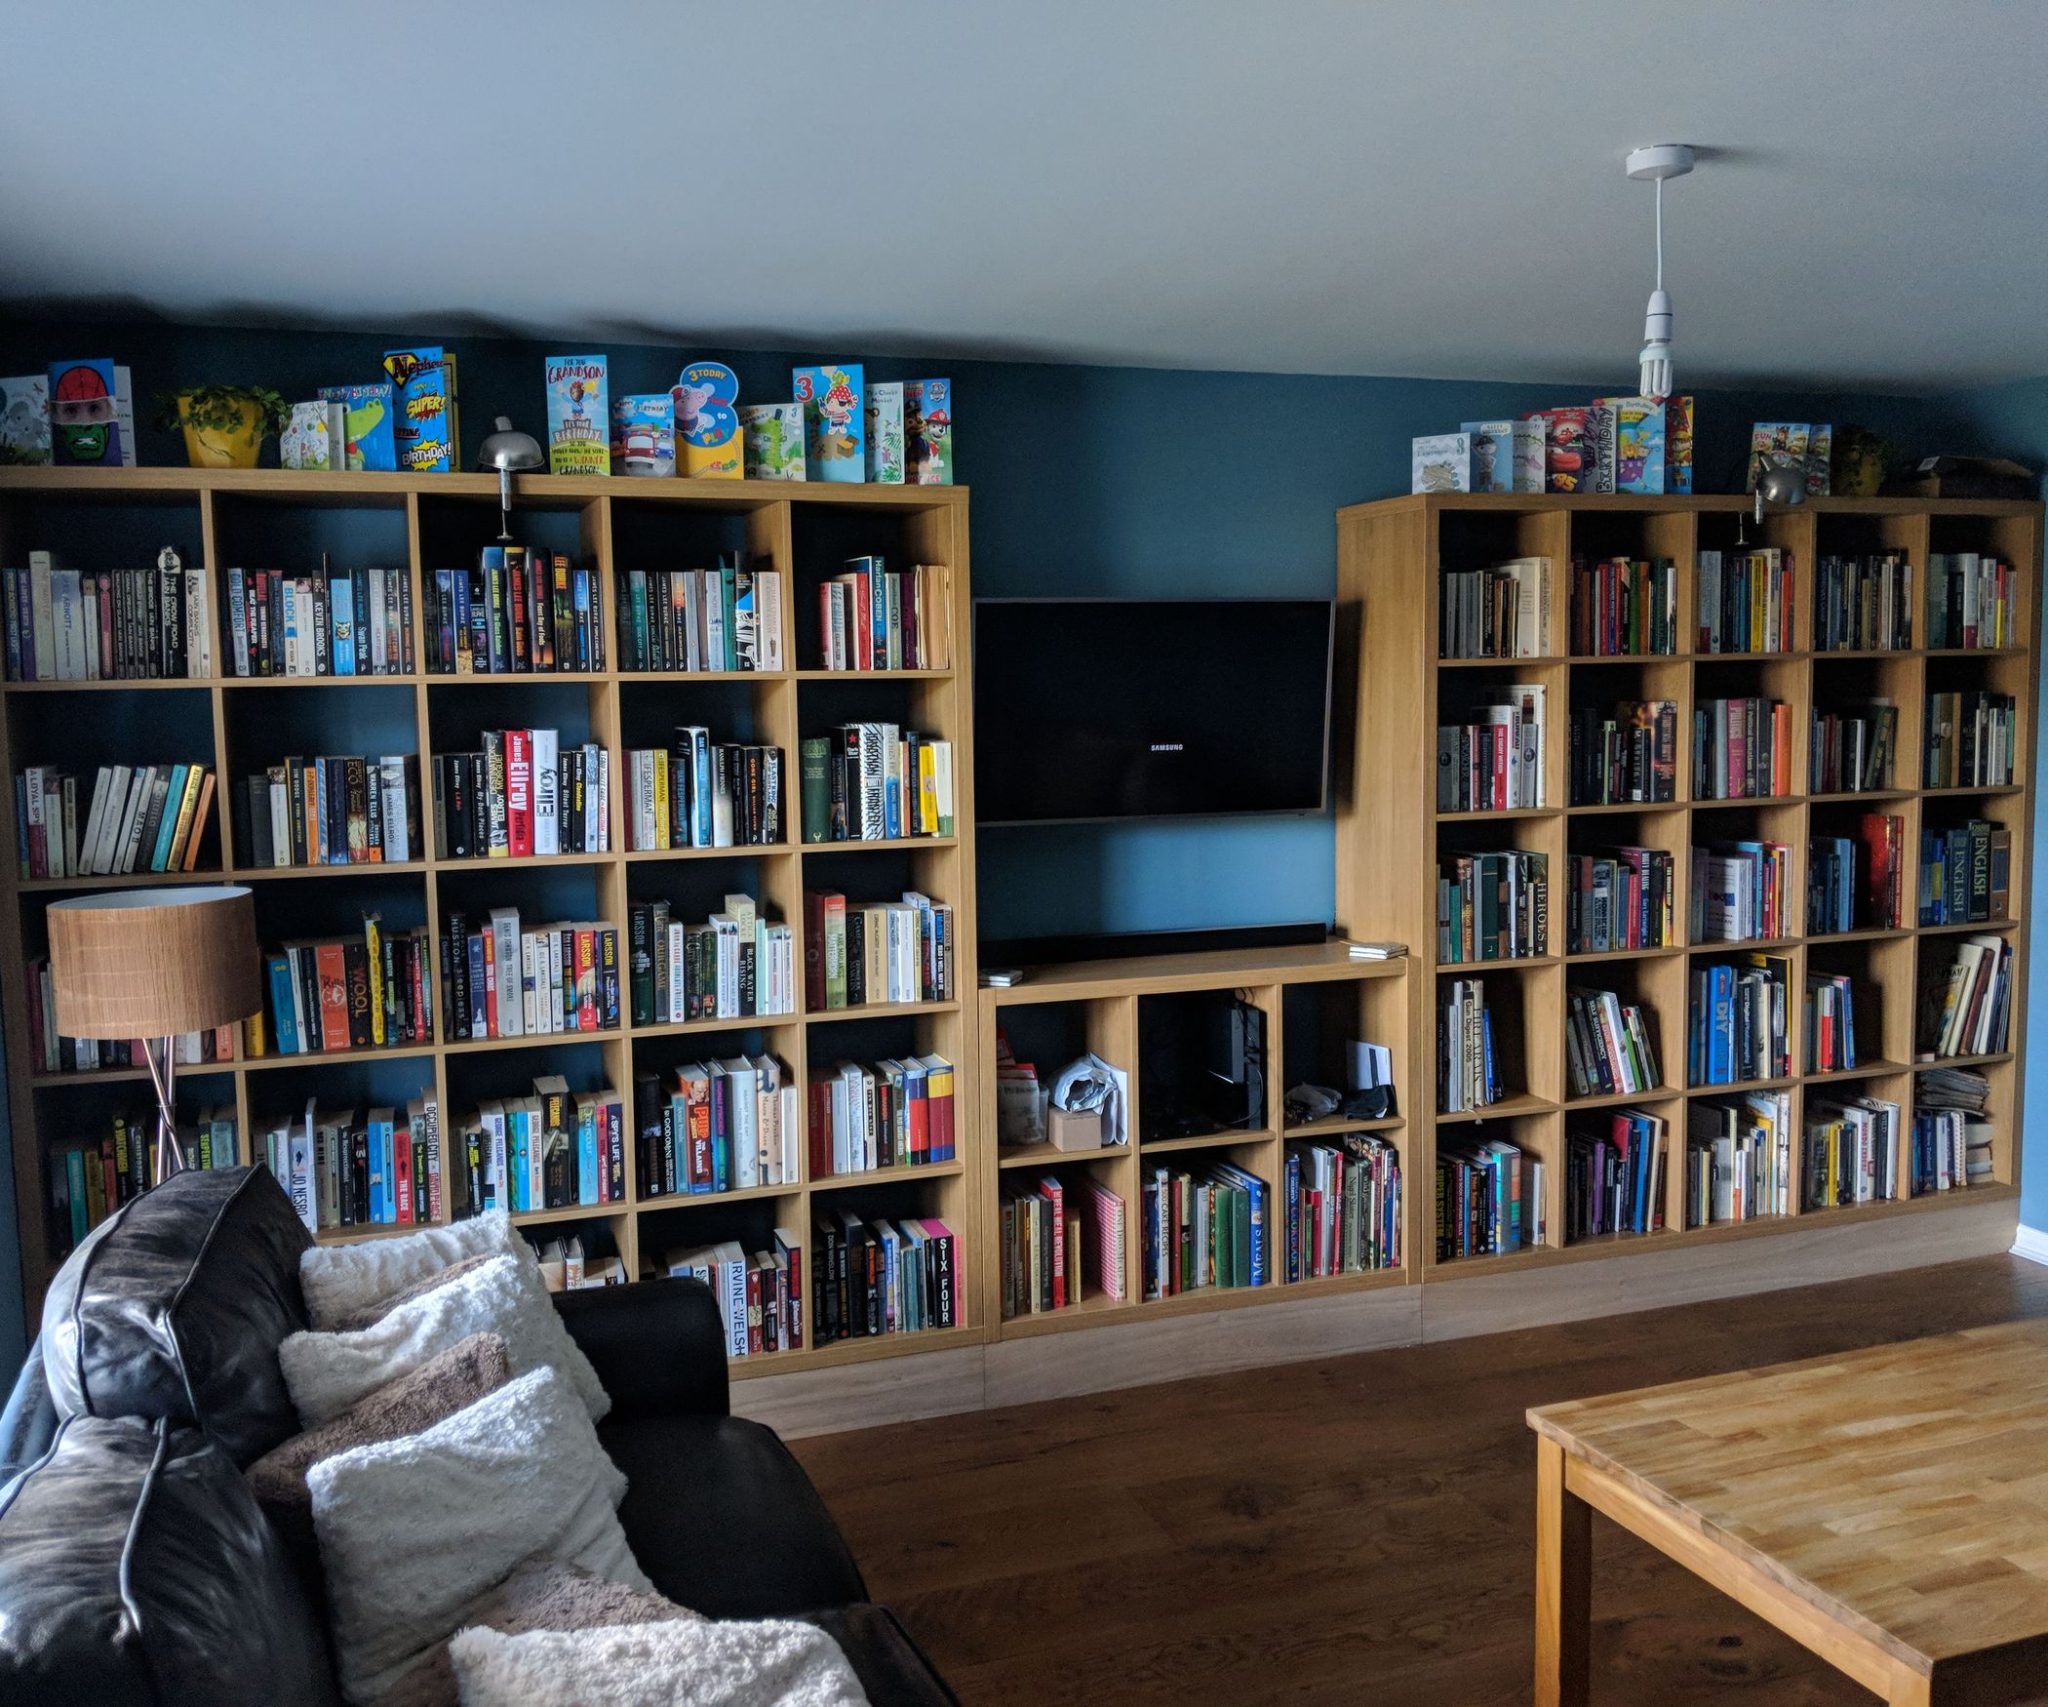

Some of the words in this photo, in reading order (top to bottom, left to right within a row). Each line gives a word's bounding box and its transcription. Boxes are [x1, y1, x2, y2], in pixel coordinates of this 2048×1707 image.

[393, 357, 447, 379] Nephew
[548, 366, 604, 384] GRANDSON
[689, 371, 698, 381] 3
[698, 369, 726, 380] TODAY
[796, 376, 814, 402] 3
[407, 397, 446, 418] SUPER!
[402, 442, 452, 466] BIRTHDAY!
[555, 556, 566, 567] LEE
[169, 577, 177, 594] THE
[874, 560, 882, 589] Harlan
[63, 596, 71, 630] ARNOTT
[170, 597, 178, 622] CROW
[232, 596, 243, 632] COMFORT
[284, 587, 295, 622] BLOCK
[315, 602, 323, 626] KEVIN
[536, 602, 544, 615] Feast
[874, 589, 883, 621] COBEN
[187, 604, 195, 647] COMPLICITY
[493, 622, 501, 634] Glass
[536, 617, 544, 626] Day
[891, 607, 899, 629] COE
[170, 624, 178, 648] ROAD
[316, 628, 325, 656] BROOKS
[358, 627, 367, 643] Swan
[494, 635, 502, 655] Rainbow
[538, 633, 546, 645] Fools
[359, 644, 368, 660] Peak
[1730, 707, 1744, 739] POLITICS
[513, 735, 523, 762] James
[575, 753, 583, 767] James
[865, 733, 880, 776] JONATHAN
[474, 760, 482, 773] James
[718, 749, 726, 772] RANULPH
[749, 758, 757, 777] GONE
[29, 769, 37, 777] A
[292, 768, 300, 778] JIM
[347, 761, 358, 785] ECO
[474, 774, 482, 789] Ellroy
[560, 773, 568, 787] Ellroy
[30, 781, 39, 806] LOYAL
[293, 780, 301, 798] DODGE
[369, 773, 377, 799] WARREN
[475, 791, 483, 801] My
[509, 762, 529, 810] Ellroy
[575, 782, 583, 812] Clandestine
[750, 778, 758, 793] GIRL
[386, 793, 394, 816] JAMES
[476, 802, 484, 816] Dark
[562, 789, 570, 807] Silent
[866, 789, 881, 828] FRANZEN
[32, 807, 41, 823] SPY
[370, 802, 378, 818] ELLIS
[562, 809, 570, 828] Terror
[133, 811, 146, 834] MAO
[387, 819, 395, 843] ELLROY
[477, 818, 485, 839] Places
[515, 811, 525, 840] Perfidia
[1973, 837, 1988, 896] ENGLISH
[1953, 851, 1966, 913] ENGLISH
[1537, 883, 1547, 941] HEROES
[1641, 898, 1649, 909] Gary
[634, 911, 645, 945] LARSSON
[1599, 897, 1607, 939] HOMICIDE
[504, 939, 513, 961] JOHNSON
[581, 934, 591, 966] LARSSON
[604, 933, 613, 966] LARSSON
[1465, 927, 1473, 950] River
[451, 918, 460, 964] HUSTON
[456, 969, 466, 1018] sleepless
[505, 964, 513, 976] TREE
[746, 948, 754, 970] BLACK
[352, 967, 367, 1018] WOOL
[507, 985, 515, 1002] SMOKE
[746, 975, 754, 1002] WATER
[1464, 1001, 1472, 1014] Gun
[1716, 1002, 1728, 1033] DIY
[1742, 1002, 1750, 1022] Digital
[1464, 1016, 1472, 1041] Digest
[1465, 1043, 1473, 1063] 2005
[1742, 1023, 1750, 1064] Photography
[771, 1095, 779, 1118] Thomas
[427, 1107, 438, 1144] OCCUPIED
[494, 1118, 502, 1137] GEORGE
[611, 1120, 619, 1143] SPY'S
[694, 1106, 709, 1138] PULP
[771, 1120, 779, 1146] Pynchon
[761, 1128, 769, 1146] Dixon
[115, 1129, 128, 1173] WATCHMEN
[342, 1139, 350, 1183] Resurrectionist
[428, 1145, 439, 1162] CITY
[495, 1138, 503, 1166] PELECANOS
[612, 1144, 620, 1161] LIFE
[696, 1140, 704, 1174] VILLAINS
[292, 1175, 306, 1184] JO
[400, 1179, 408, 1192] THE
[1347, 1176, 1357, 1195] Nigel
[1436, 1169, 1444, 1199] SUPER
[400, 1194, 408, 1211] RACE
[1054, 1199, 1062, 1216] REAL
[1161, 1203, 1169, 1223] CAKE
[1349, 1197, 1357, 1219] Slater
[1054, 1218, 1063, 1235] MEAL
[1436, 1201, 1444, 1237] SYSTEM
[827, 1235, 835, 1249] DON
[1161, 1226, 1169, 1257] RECIPES
[1291, 1207, 1299, 1267] COOKBOOK
[828, 1251, 836, 1280] WINSLOW
[940, 1238, 948, 1272] SIX
[1055, 1236, 1063, 1276] REVOLUTION
[732, 1261, 744, 1305] IRVINE
[941, 1278, 949, 1322] FOUR
[734, 1309, 746, 1356] WELSH
